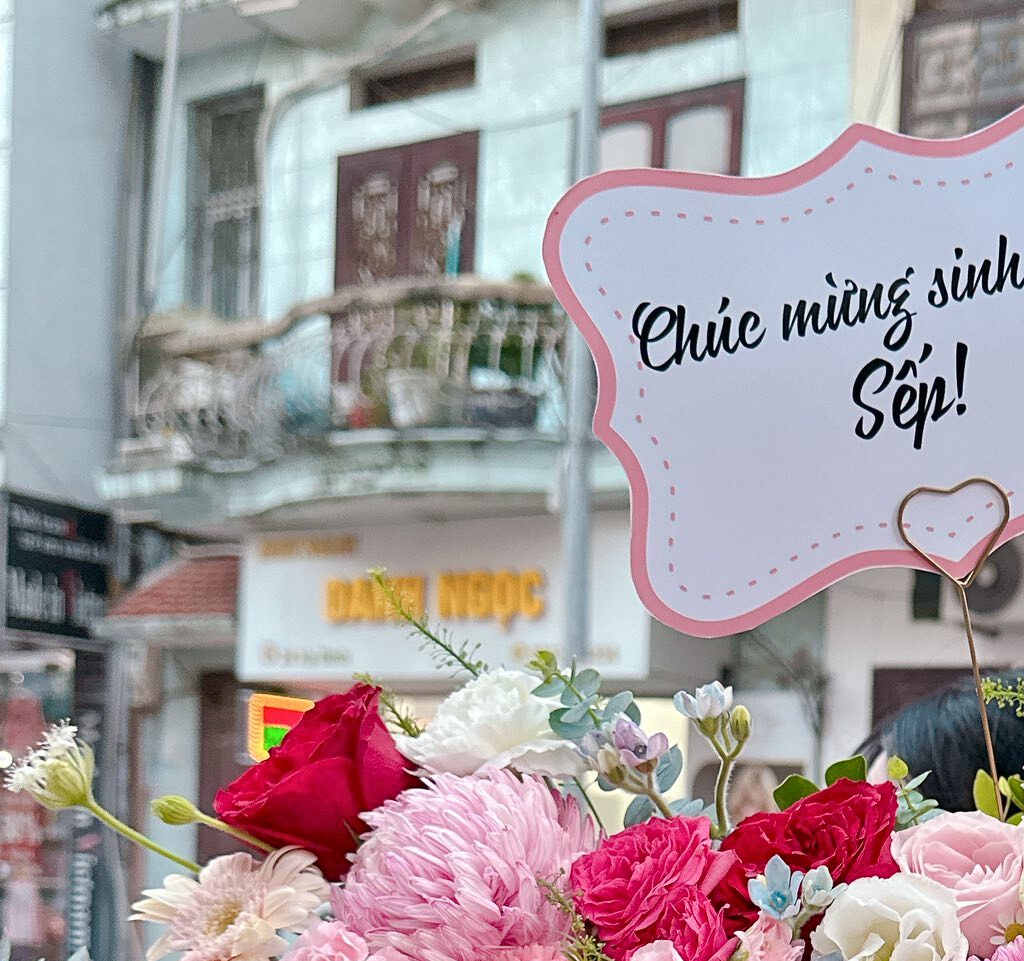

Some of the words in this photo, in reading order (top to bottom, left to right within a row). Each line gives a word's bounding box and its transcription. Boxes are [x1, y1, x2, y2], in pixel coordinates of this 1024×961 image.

[631, 296, 767, 372] Chúc
[782, 266, 918, 352] mừng
[852, 341, 969, 450] Sếp!
